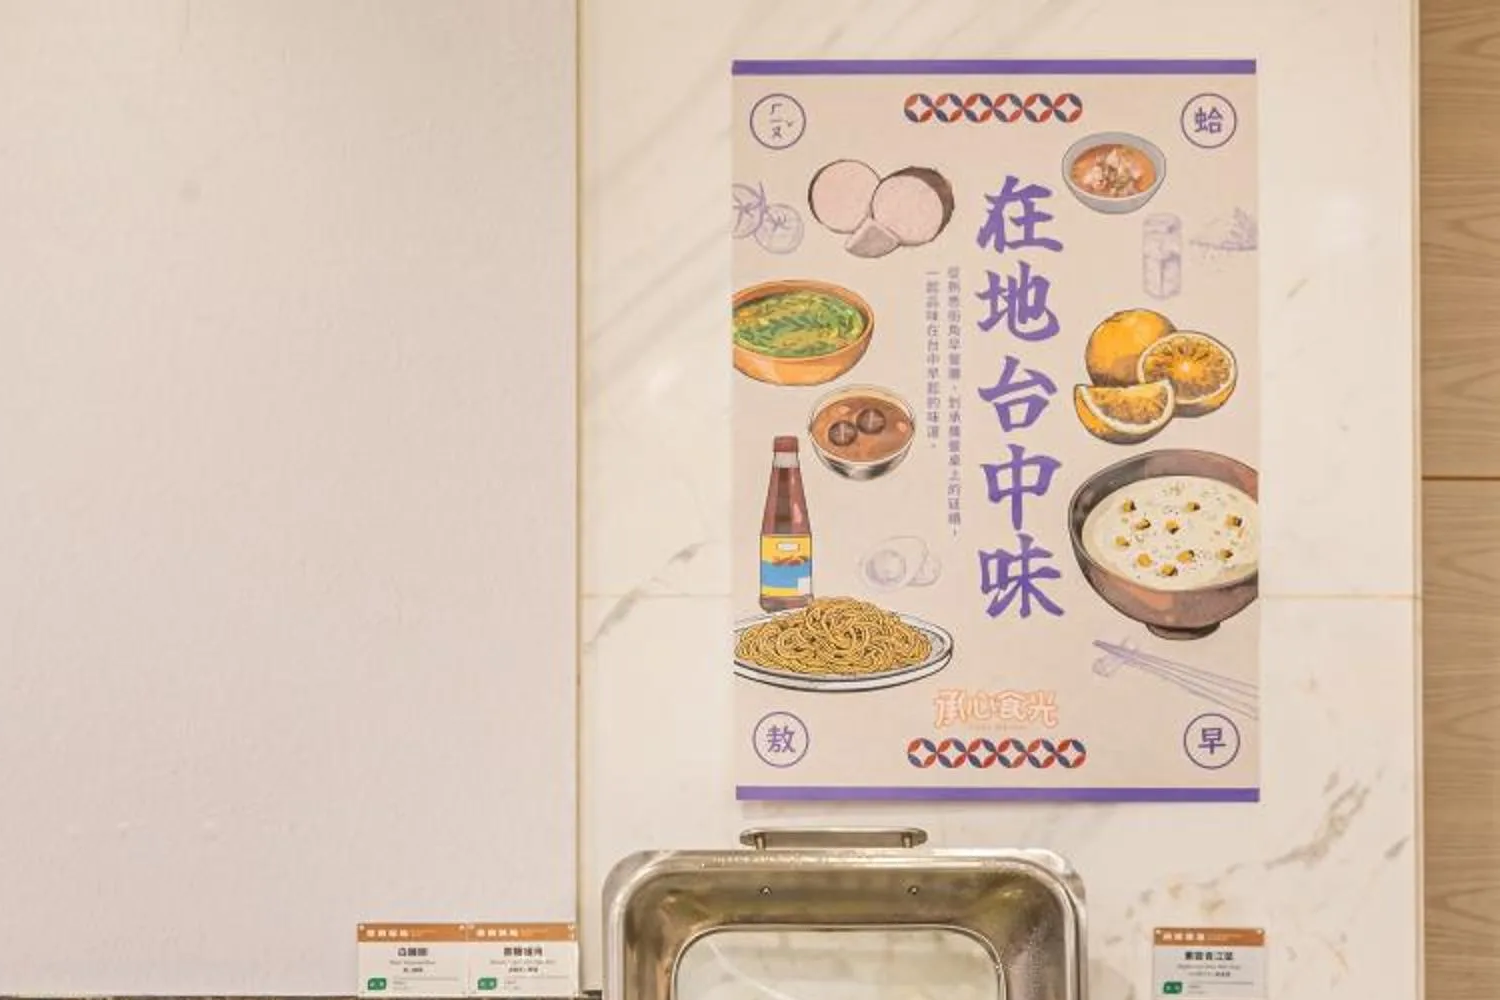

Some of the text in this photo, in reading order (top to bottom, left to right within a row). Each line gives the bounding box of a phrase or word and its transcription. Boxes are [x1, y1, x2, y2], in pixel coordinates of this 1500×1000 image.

[1194, 106, 1223, 135] 蛤
[978, 176, 1064, 618] 在地台中味
[934, 688, 1059, 728] 承心食光
[766, 727, 796, 754] 敖
[1198, 727, 1227, 755] 早
